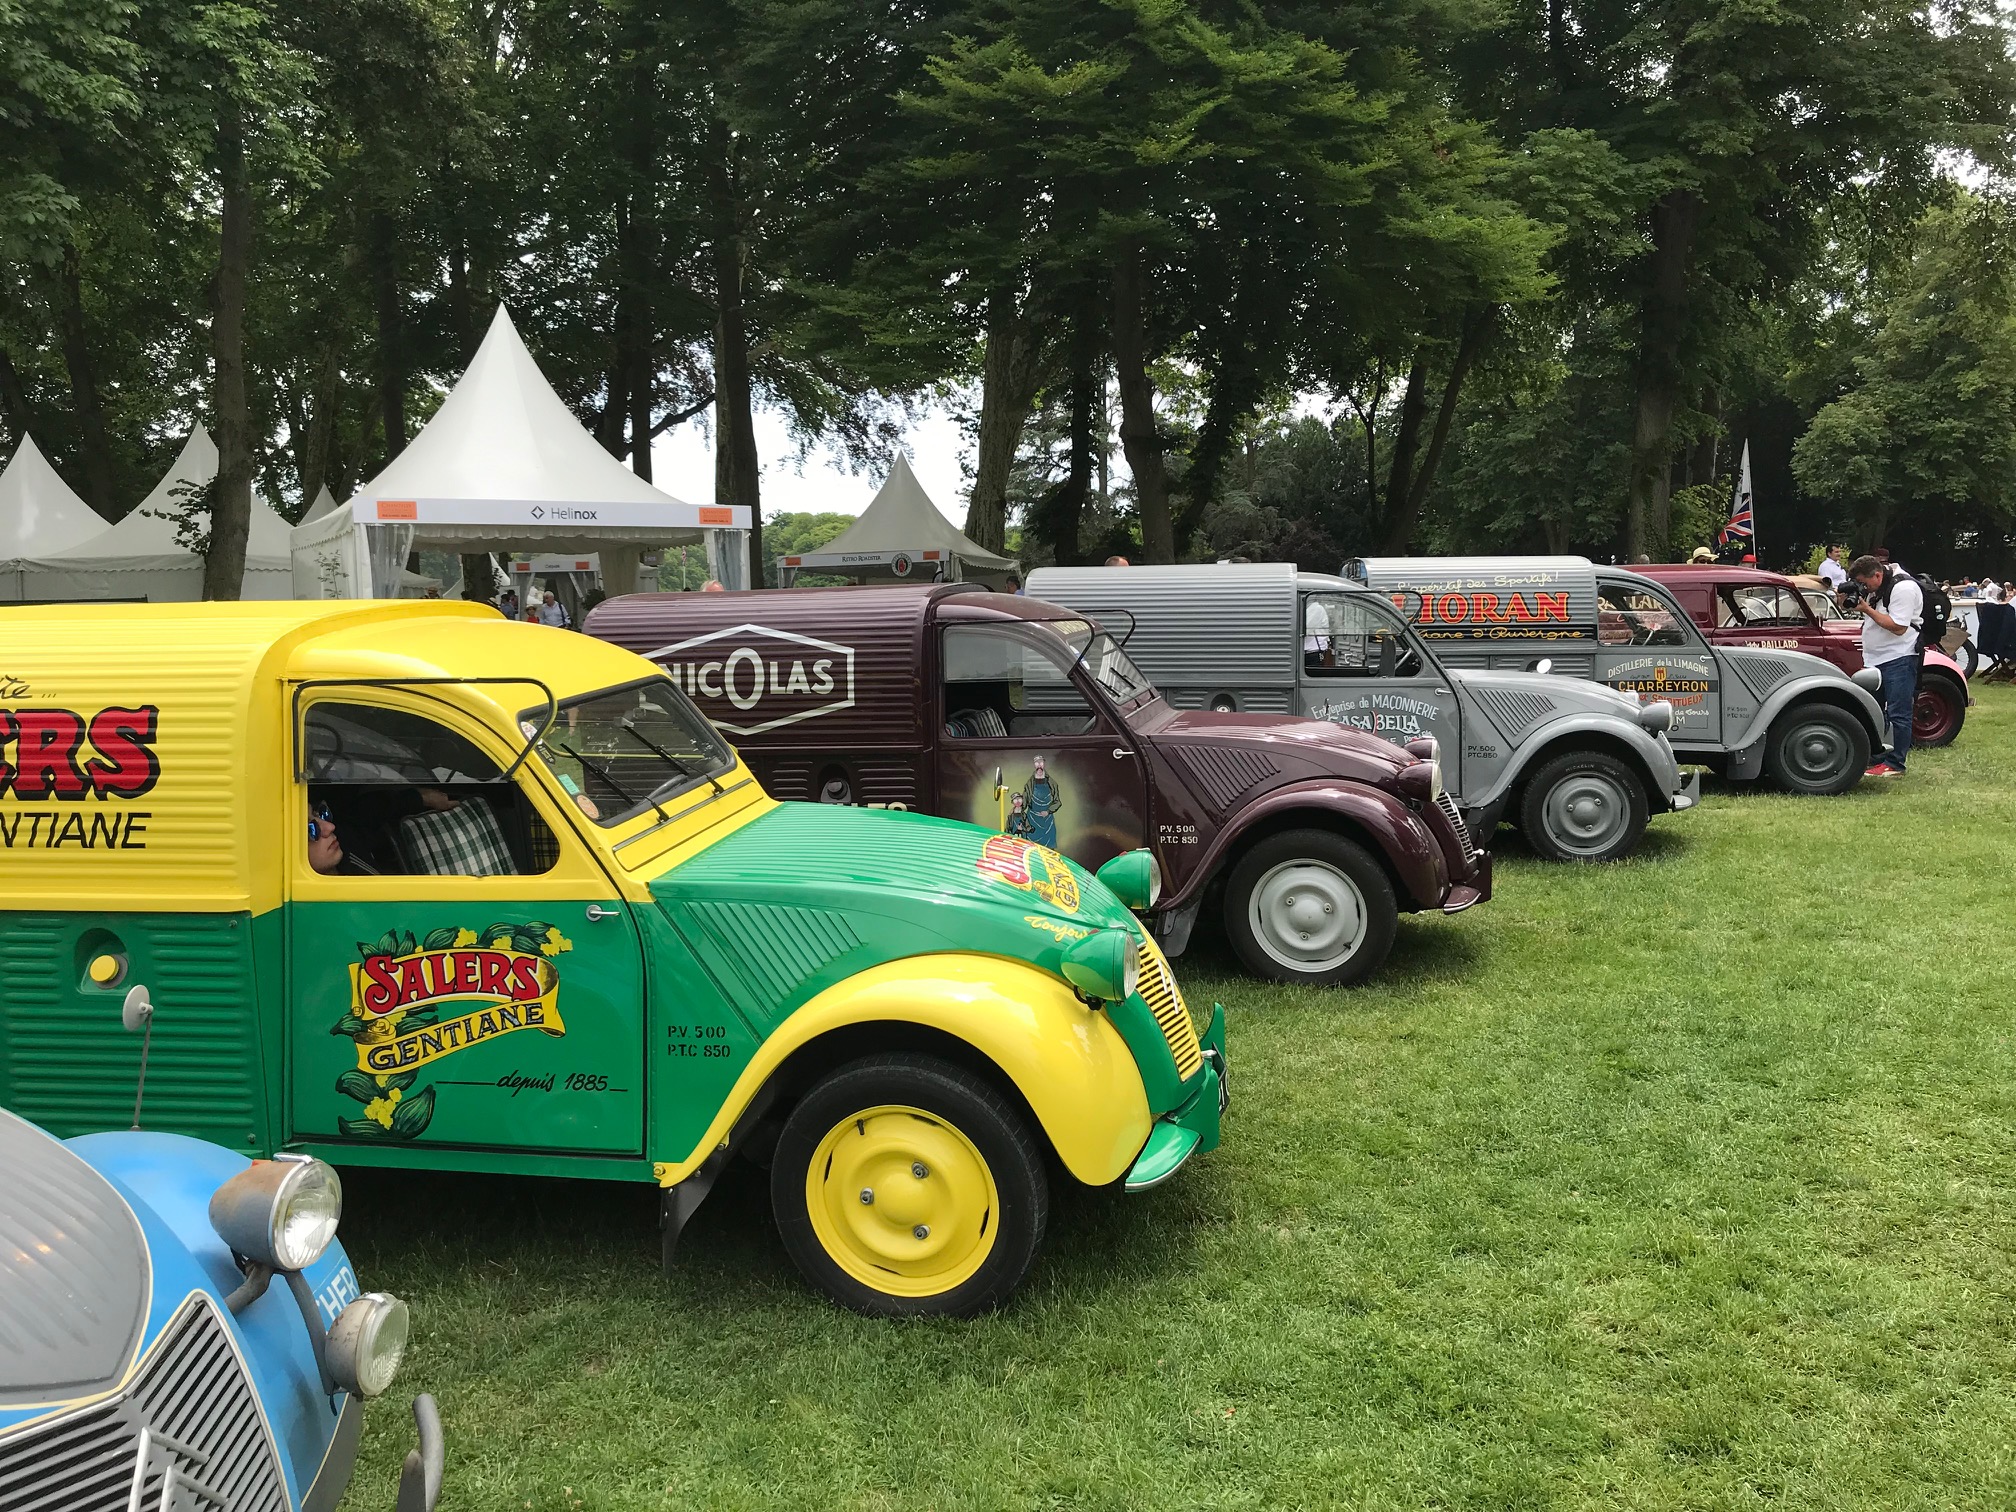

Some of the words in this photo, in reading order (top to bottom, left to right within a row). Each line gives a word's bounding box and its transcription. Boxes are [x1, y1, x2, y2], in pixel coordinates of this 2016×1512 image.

[551, 507, 597, 520] Helinox
[1466, 578, 1486, 589] des
[1608, 657, 1653, 679] DISTILLERIE
[1656, 658, 1665, 667] de
[1665, 657, 1673, 667] la
[1673, 658, 1709, 677] LIMAGNE
[656, 647, 834, 710] NICOLAS
[1618, 681, 1709, 692] CHARREYRON
[1358, 696, 1370, 710] de
[1372, 694, 1439, 721] MAÇONNERIE
[1479, 745, 1496, 753] 500
[1159, 825, 1175, 833] P.V.
[1176, 825, 1195, 833] 500
[1181, 836, 1199, 844] 850
[365, 951, 540, 1014] SALERS
[367, 1002, 545, 1069] GENTIANE
[694, 1025, 726, 1039] 500
[703, 1044, 731, 1058] 850
[496, 1069, 555, 1098] depuis
[564, 1072, 608, 1091] 1885
